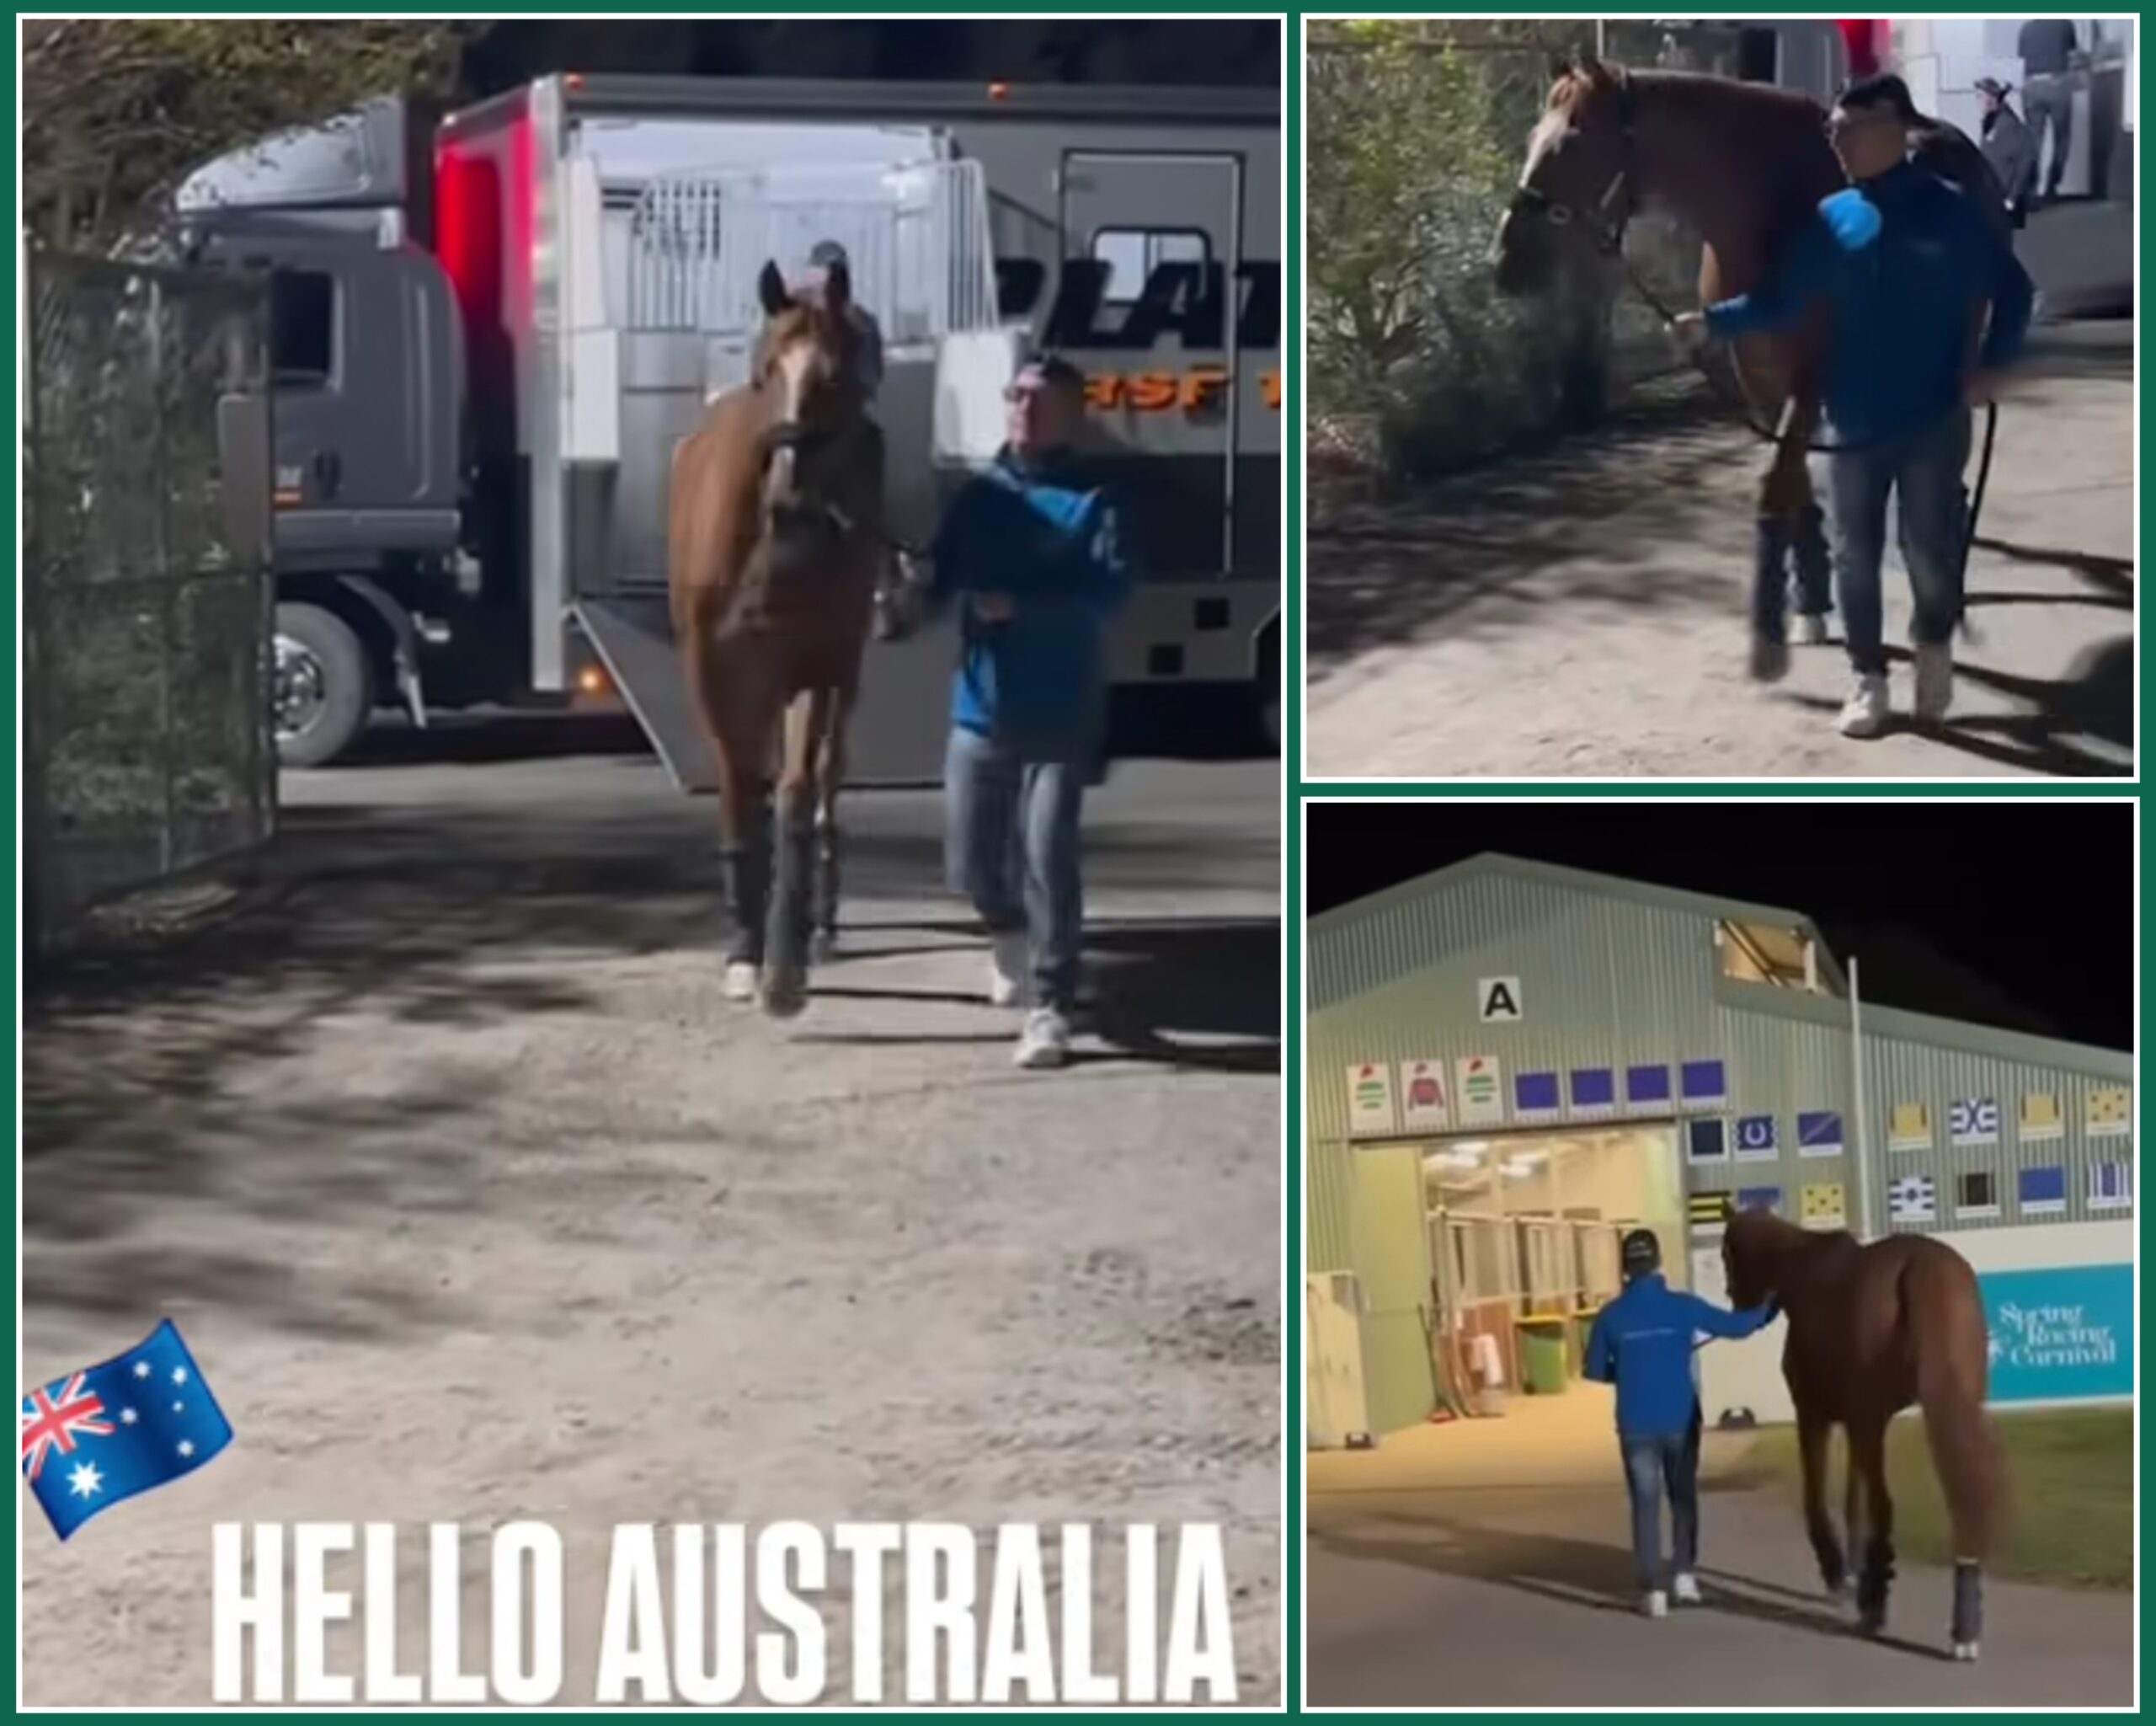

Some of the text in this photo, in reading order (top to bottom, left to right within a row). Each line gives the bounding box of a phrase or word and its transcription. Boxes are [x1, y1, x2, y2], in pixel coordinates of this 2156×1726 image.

[1484, 982, 1518, 1017] A
[1998, 1302, 2083, 1333] Spring
[2026, 1323, 2111, 1349] Racing
[2009, 1338, 2116, 1366] Carnival
